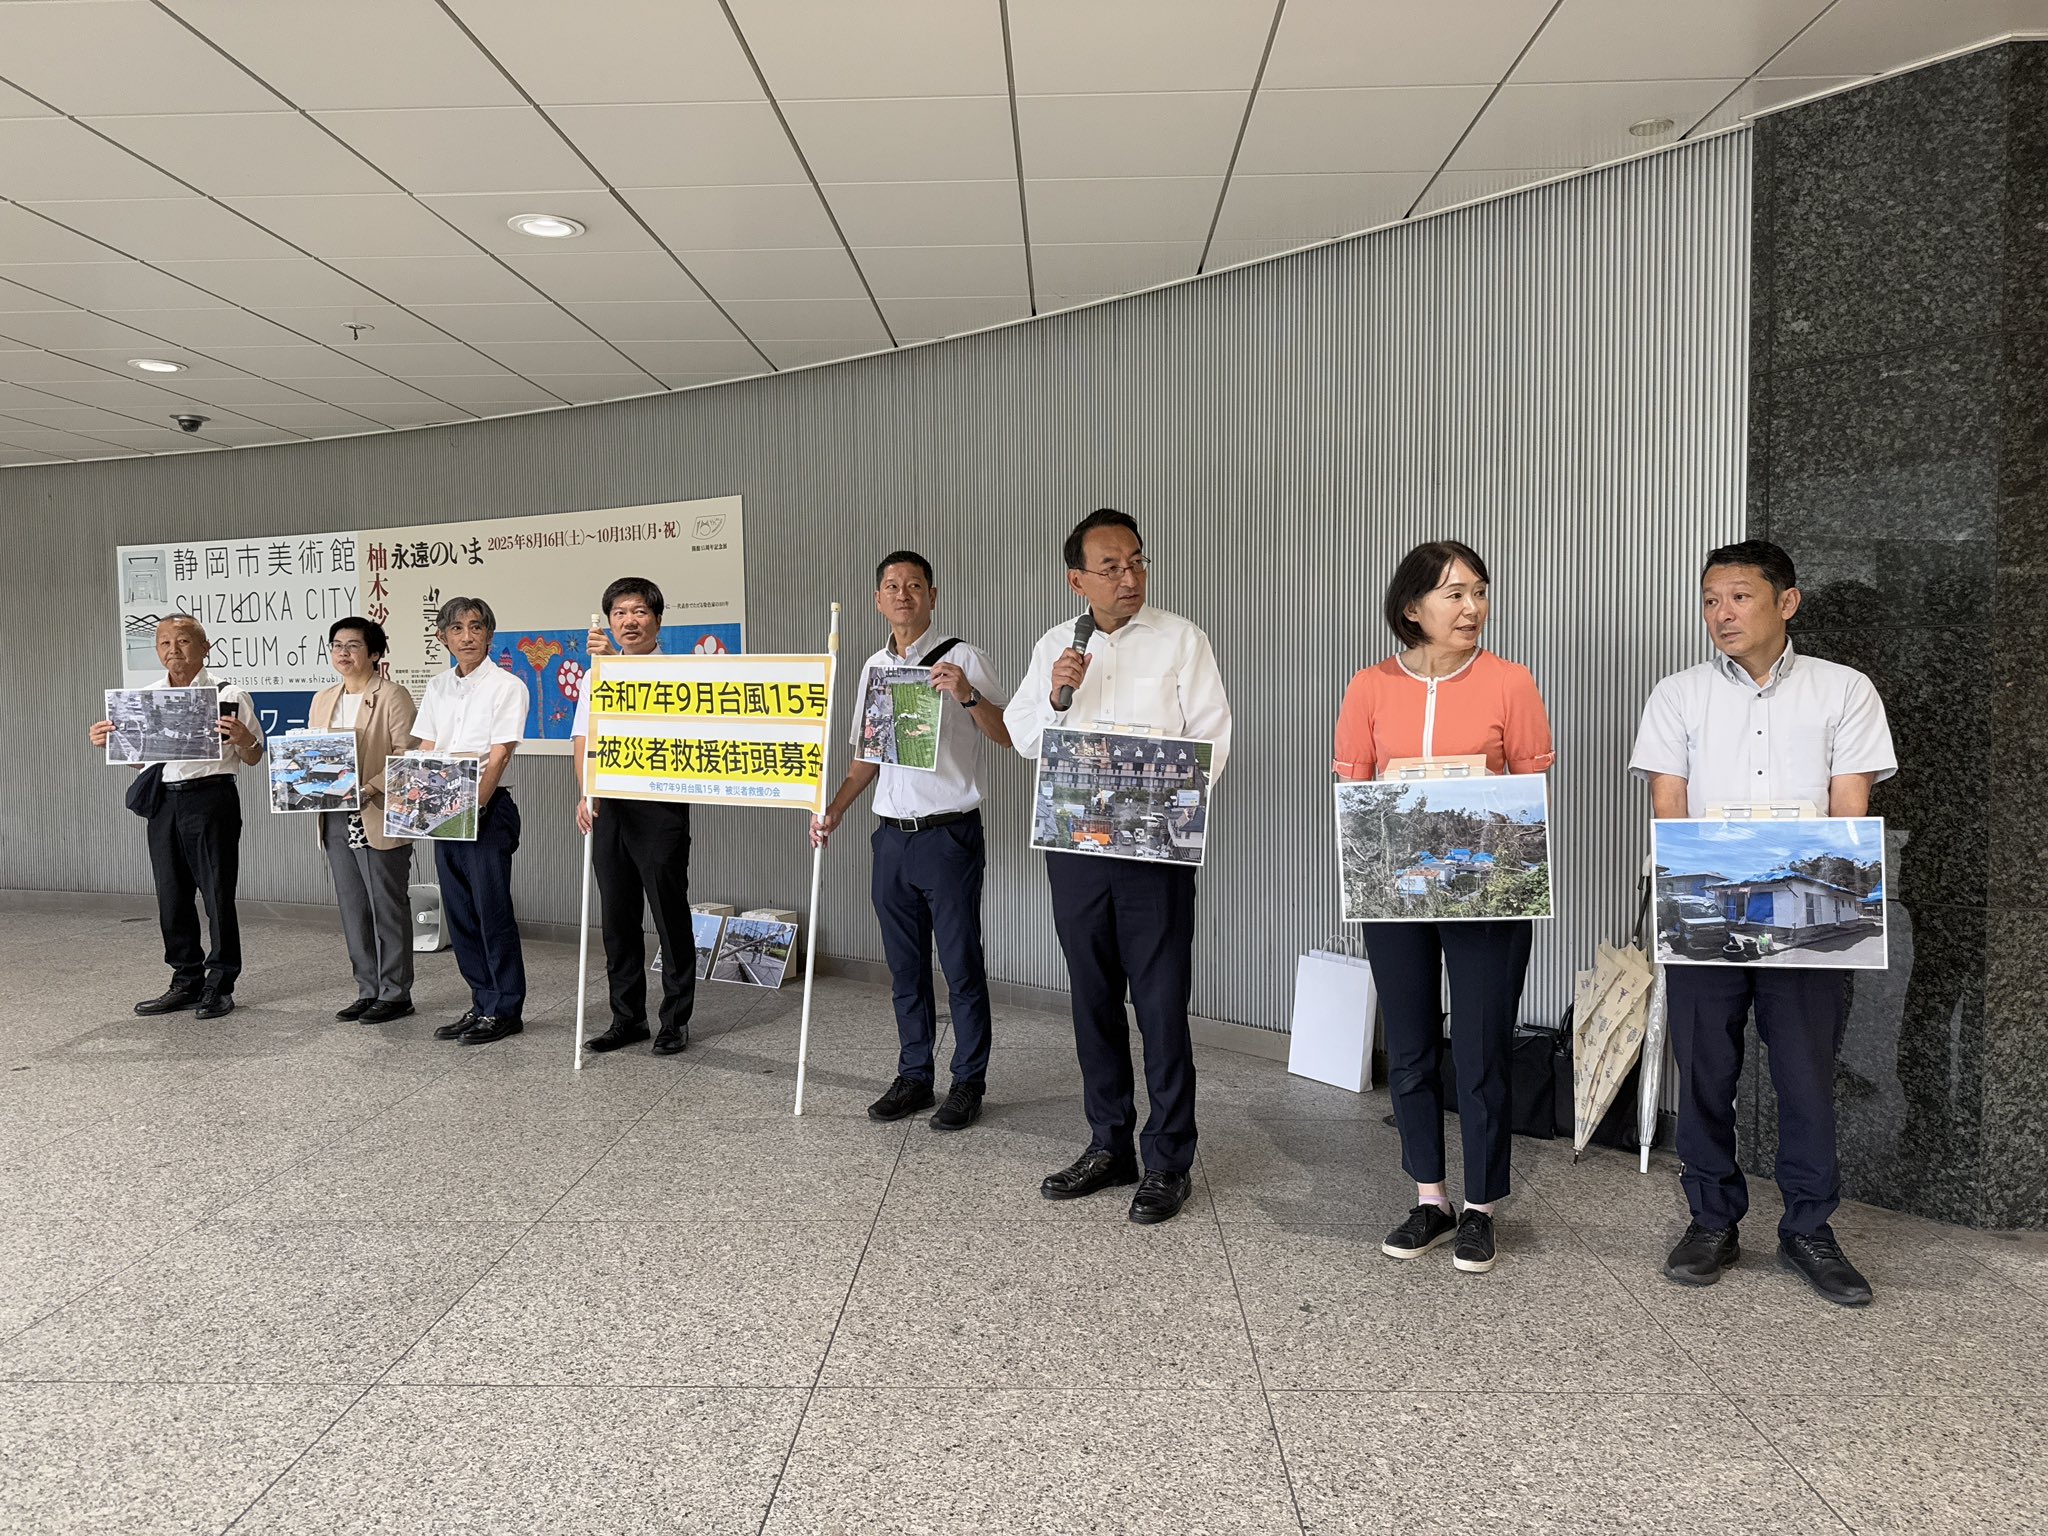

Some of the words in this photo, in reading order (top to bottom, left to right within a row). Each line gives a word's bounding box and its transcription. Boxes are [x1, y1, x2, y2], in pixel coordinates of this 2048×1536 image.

[173, 537, 356, 581] 静岡市美術館
[391, 536, 484, 570] 永遠のいま
[175, 591, 293, 624] SHIZUOKA
[305, 586, 357, 620] CITY
[204, 635, 279, 668] SEUM
[286, 635, 307, 667] of
[593, 680, 828, 717] 令和7年9月台風15号
[597, 735, 823, 778] 被災者救援街頭募金
[648, 781, 721, 796] 令和7年9月台風15号
[725, 785, 780, 797] 被災者救援の会
